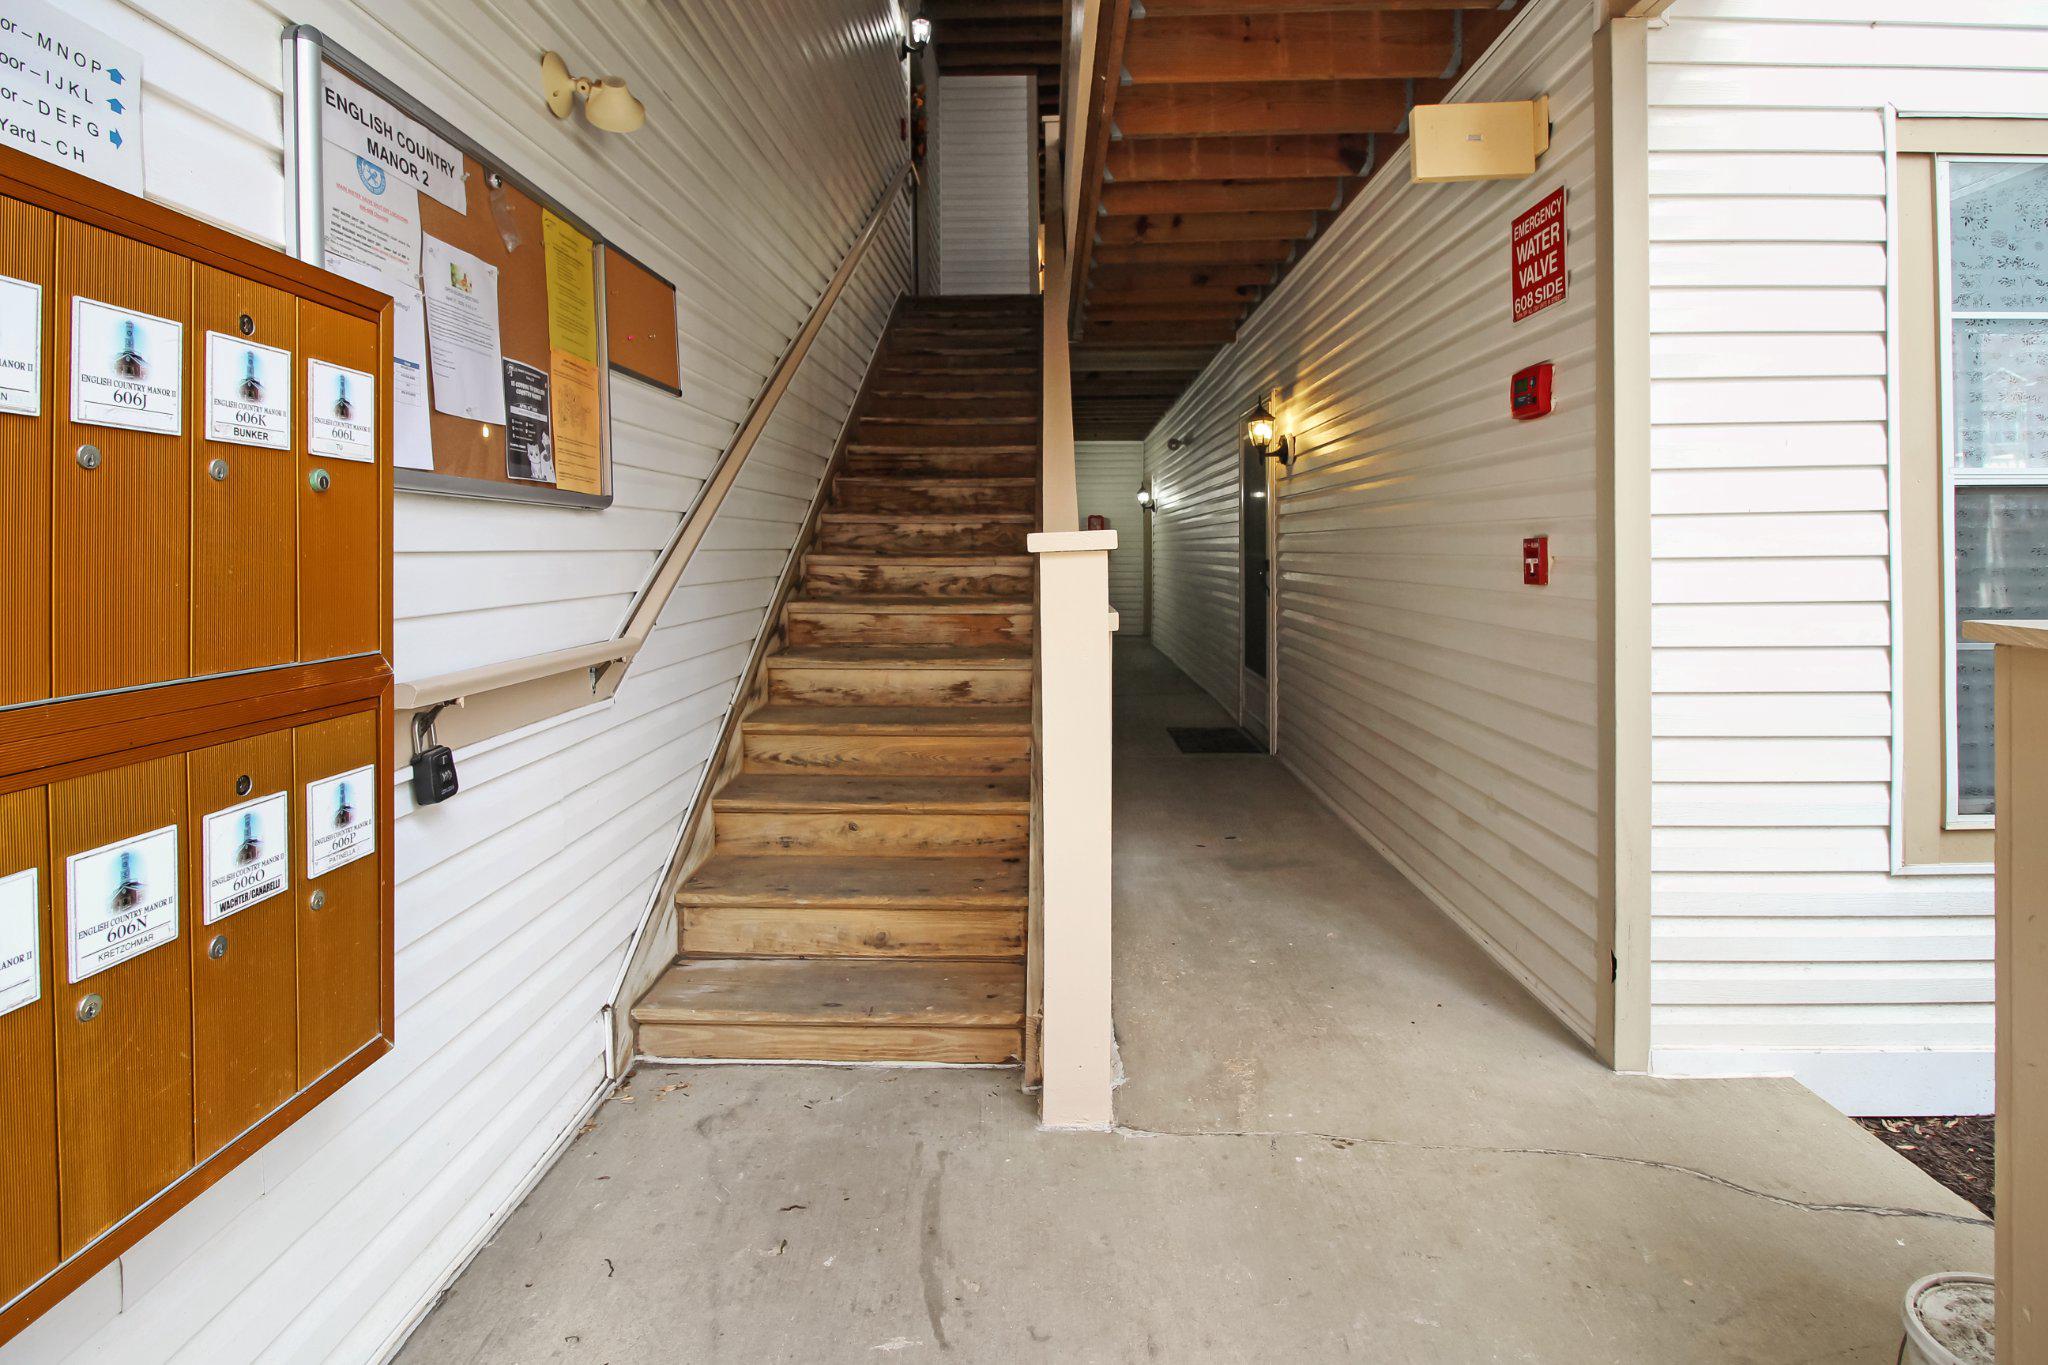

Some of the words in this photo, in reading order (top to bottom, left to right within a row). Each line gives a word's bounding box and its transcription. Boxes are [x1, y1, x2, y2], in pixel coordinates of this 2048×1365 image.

[325, 86, 393, 141] ENGLISH
[396, 131, 455, 178] COUNTRY
[366, 137, 420, 182] MANOR
[422, 170, 430, 187] 2
[1514, 196, 1563, 242] EMERGENCY
[1516, 221, 1560, 265] WATER
[1519, 249, 1558, 289] VALVE
[1514, 291, 1534, 314] 608
[1534, 276, 1564, 304] SIDE
[0, 357, 26, 371] ANOR
[81, 373, 113, 387] ENGLISH
[113, 379, 146, 393] COUNTRY
[147, 386, 171, 397] MANOR
[113, 389, 147, 411] 606J
[214, 398, 238, 409] ENGLISH
[235, 409, 267, 427] 606K
[233, 427, 269, 441] BUNKER
[332, 427, 355, 442] 606L
[332, 832, 356, 851] 606P
[211, 871, 235, 887] ENGLISH
[235, 861, 261, 878] COUNTRY
[78, 921, 109, 940] ENGLISH
[110, 907, 142, 927] COUNTRY
[143, 899, 167, 913] MANOR
[107, 915, 148, 943] 606N
[0, 953, 25, 970] ANOR
